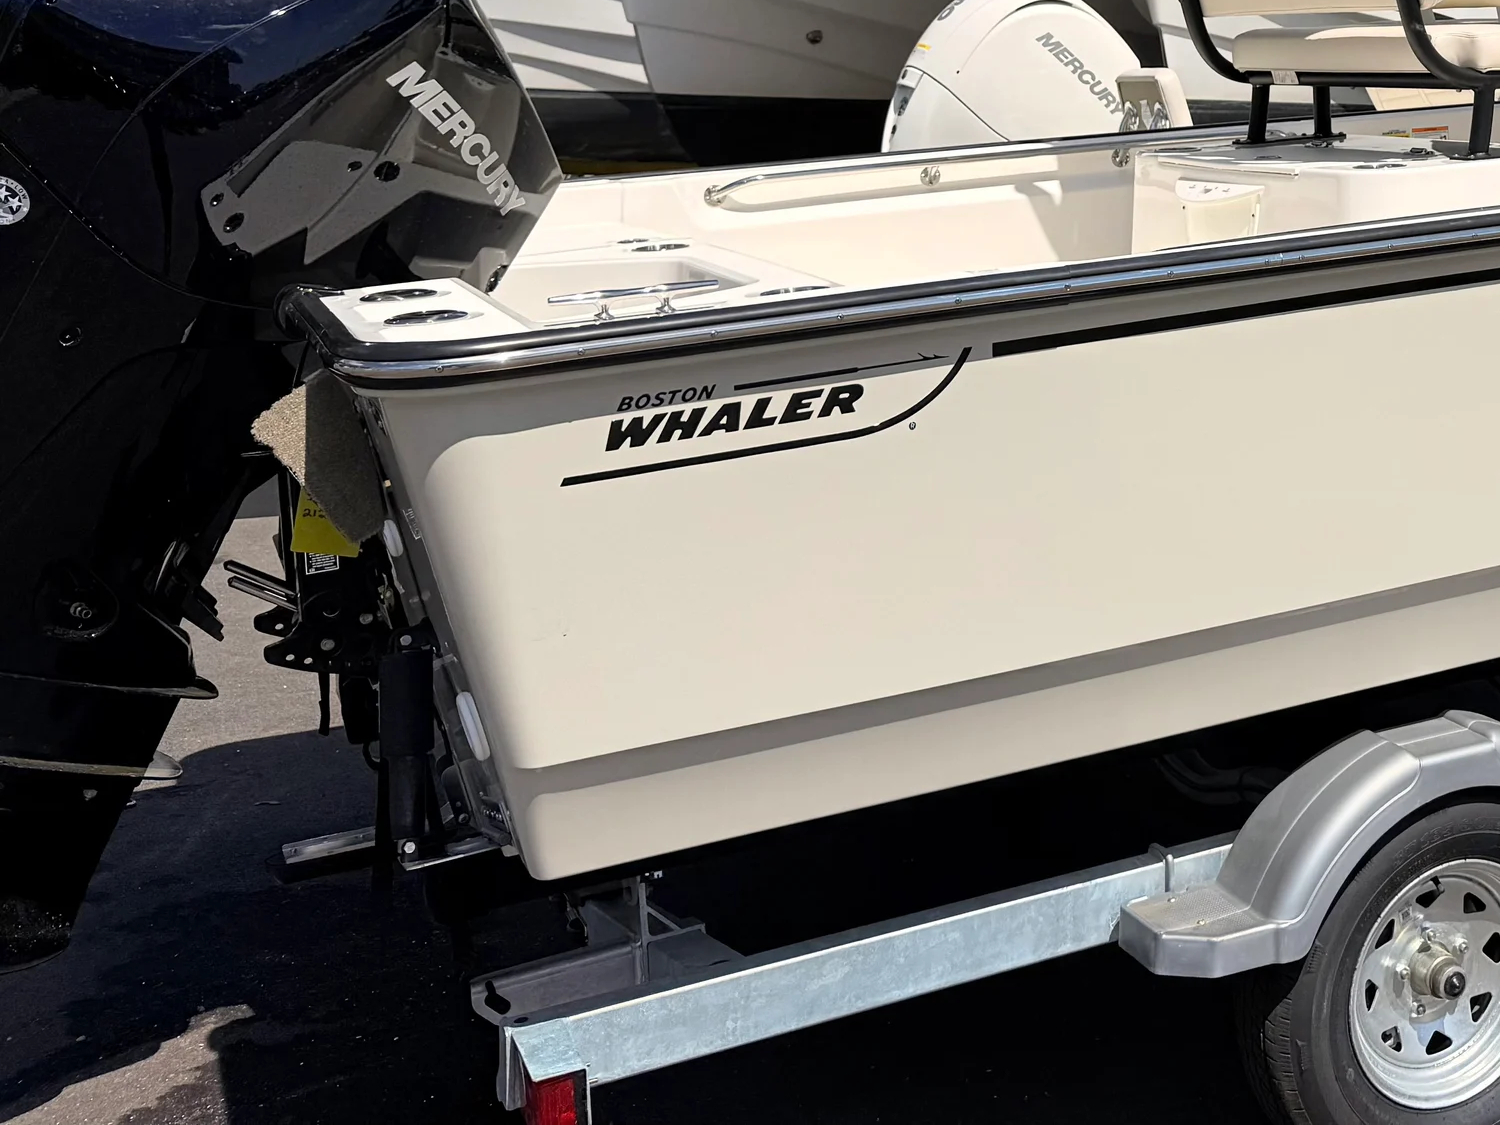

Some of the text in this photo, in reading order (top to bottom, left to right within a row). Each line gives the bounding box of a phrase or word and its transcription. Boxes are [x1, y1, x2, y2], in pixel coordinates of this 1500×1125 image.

[1035, 32, 1124, 115] MERCURY
[385, 61, 526, 216] MERCURY
[605, 383, 865, 452] WHALER
[617, 384, 717, 412] BOSTON
